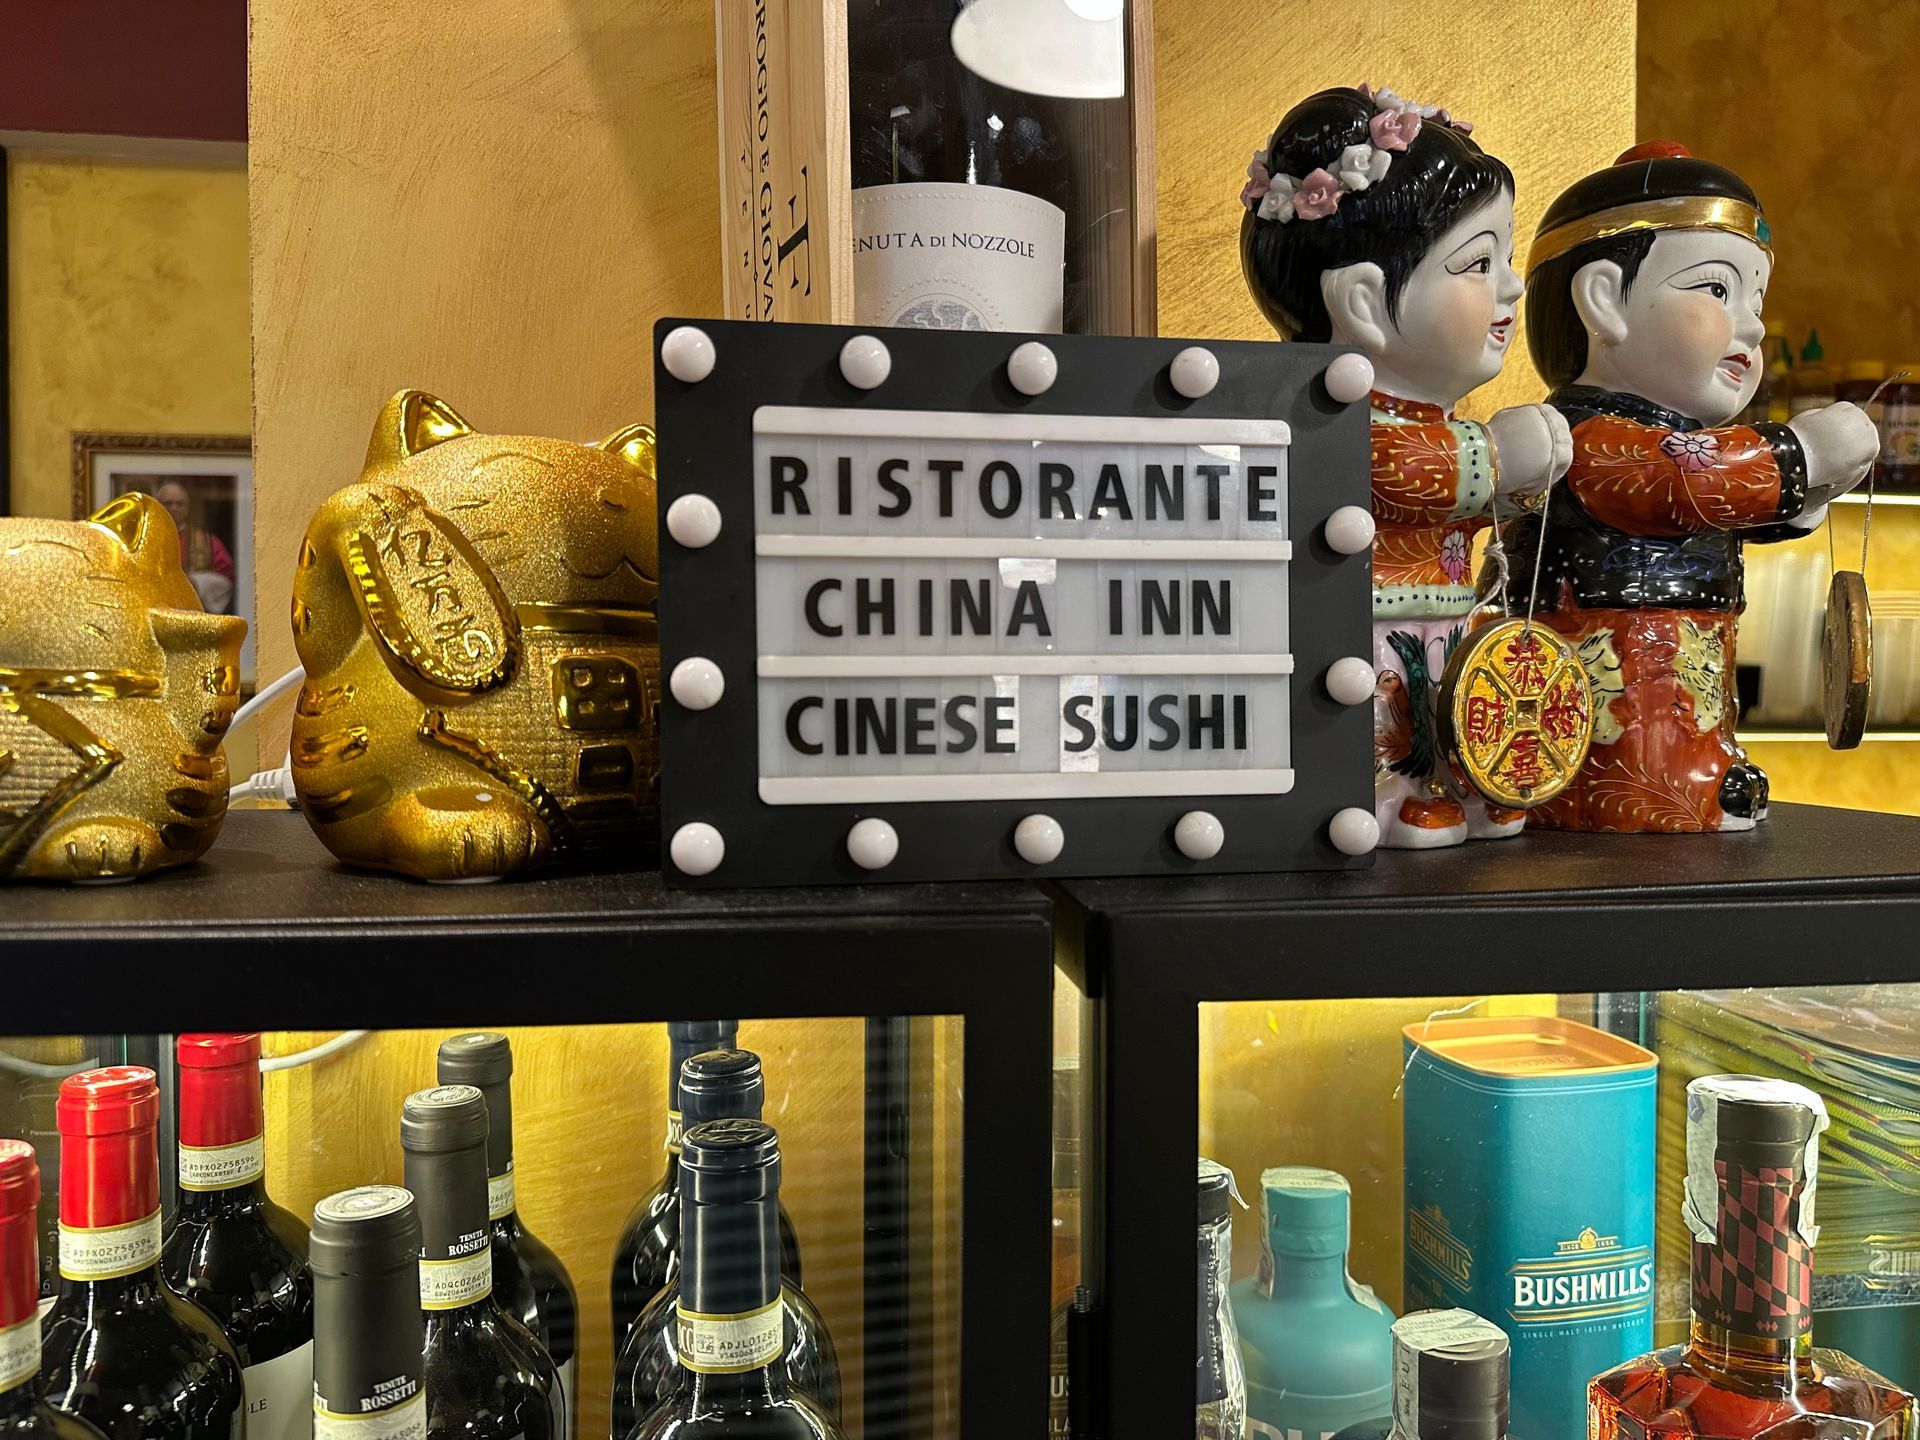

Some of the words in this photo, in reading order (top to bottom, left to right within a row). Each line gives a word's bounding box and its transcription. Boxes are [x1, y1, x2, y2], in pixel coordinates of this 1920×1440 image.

[760, 181, 774, 322] GIOVA
[952, 232, 1035, 259] NOZZOLE
[769, 456, 1279, 524] RISTORANTE
[803, 578, 1053, 638] CHINA
[1108, 579, 1233, 637] INN
[784, 695, 1017, 757] CINESE
[1063, 694, 1249, 754] SUSHI
[448, 1234, 489, 1257] ROSSETTI
[42, 1278, 51, 1291] 6
[1513, 1264, 1651, 1307] BUSHMILLS
[1522, 1331, 1554, 1339] SINGLE
[1558, 1328, 1580, 1336] MALT
[1584, 1325, 1608, 1333] IRISH
[1612, 1319, 1645, 1330] WHISKEY
[360, 1379, 418, 1412] ROSSETTI
